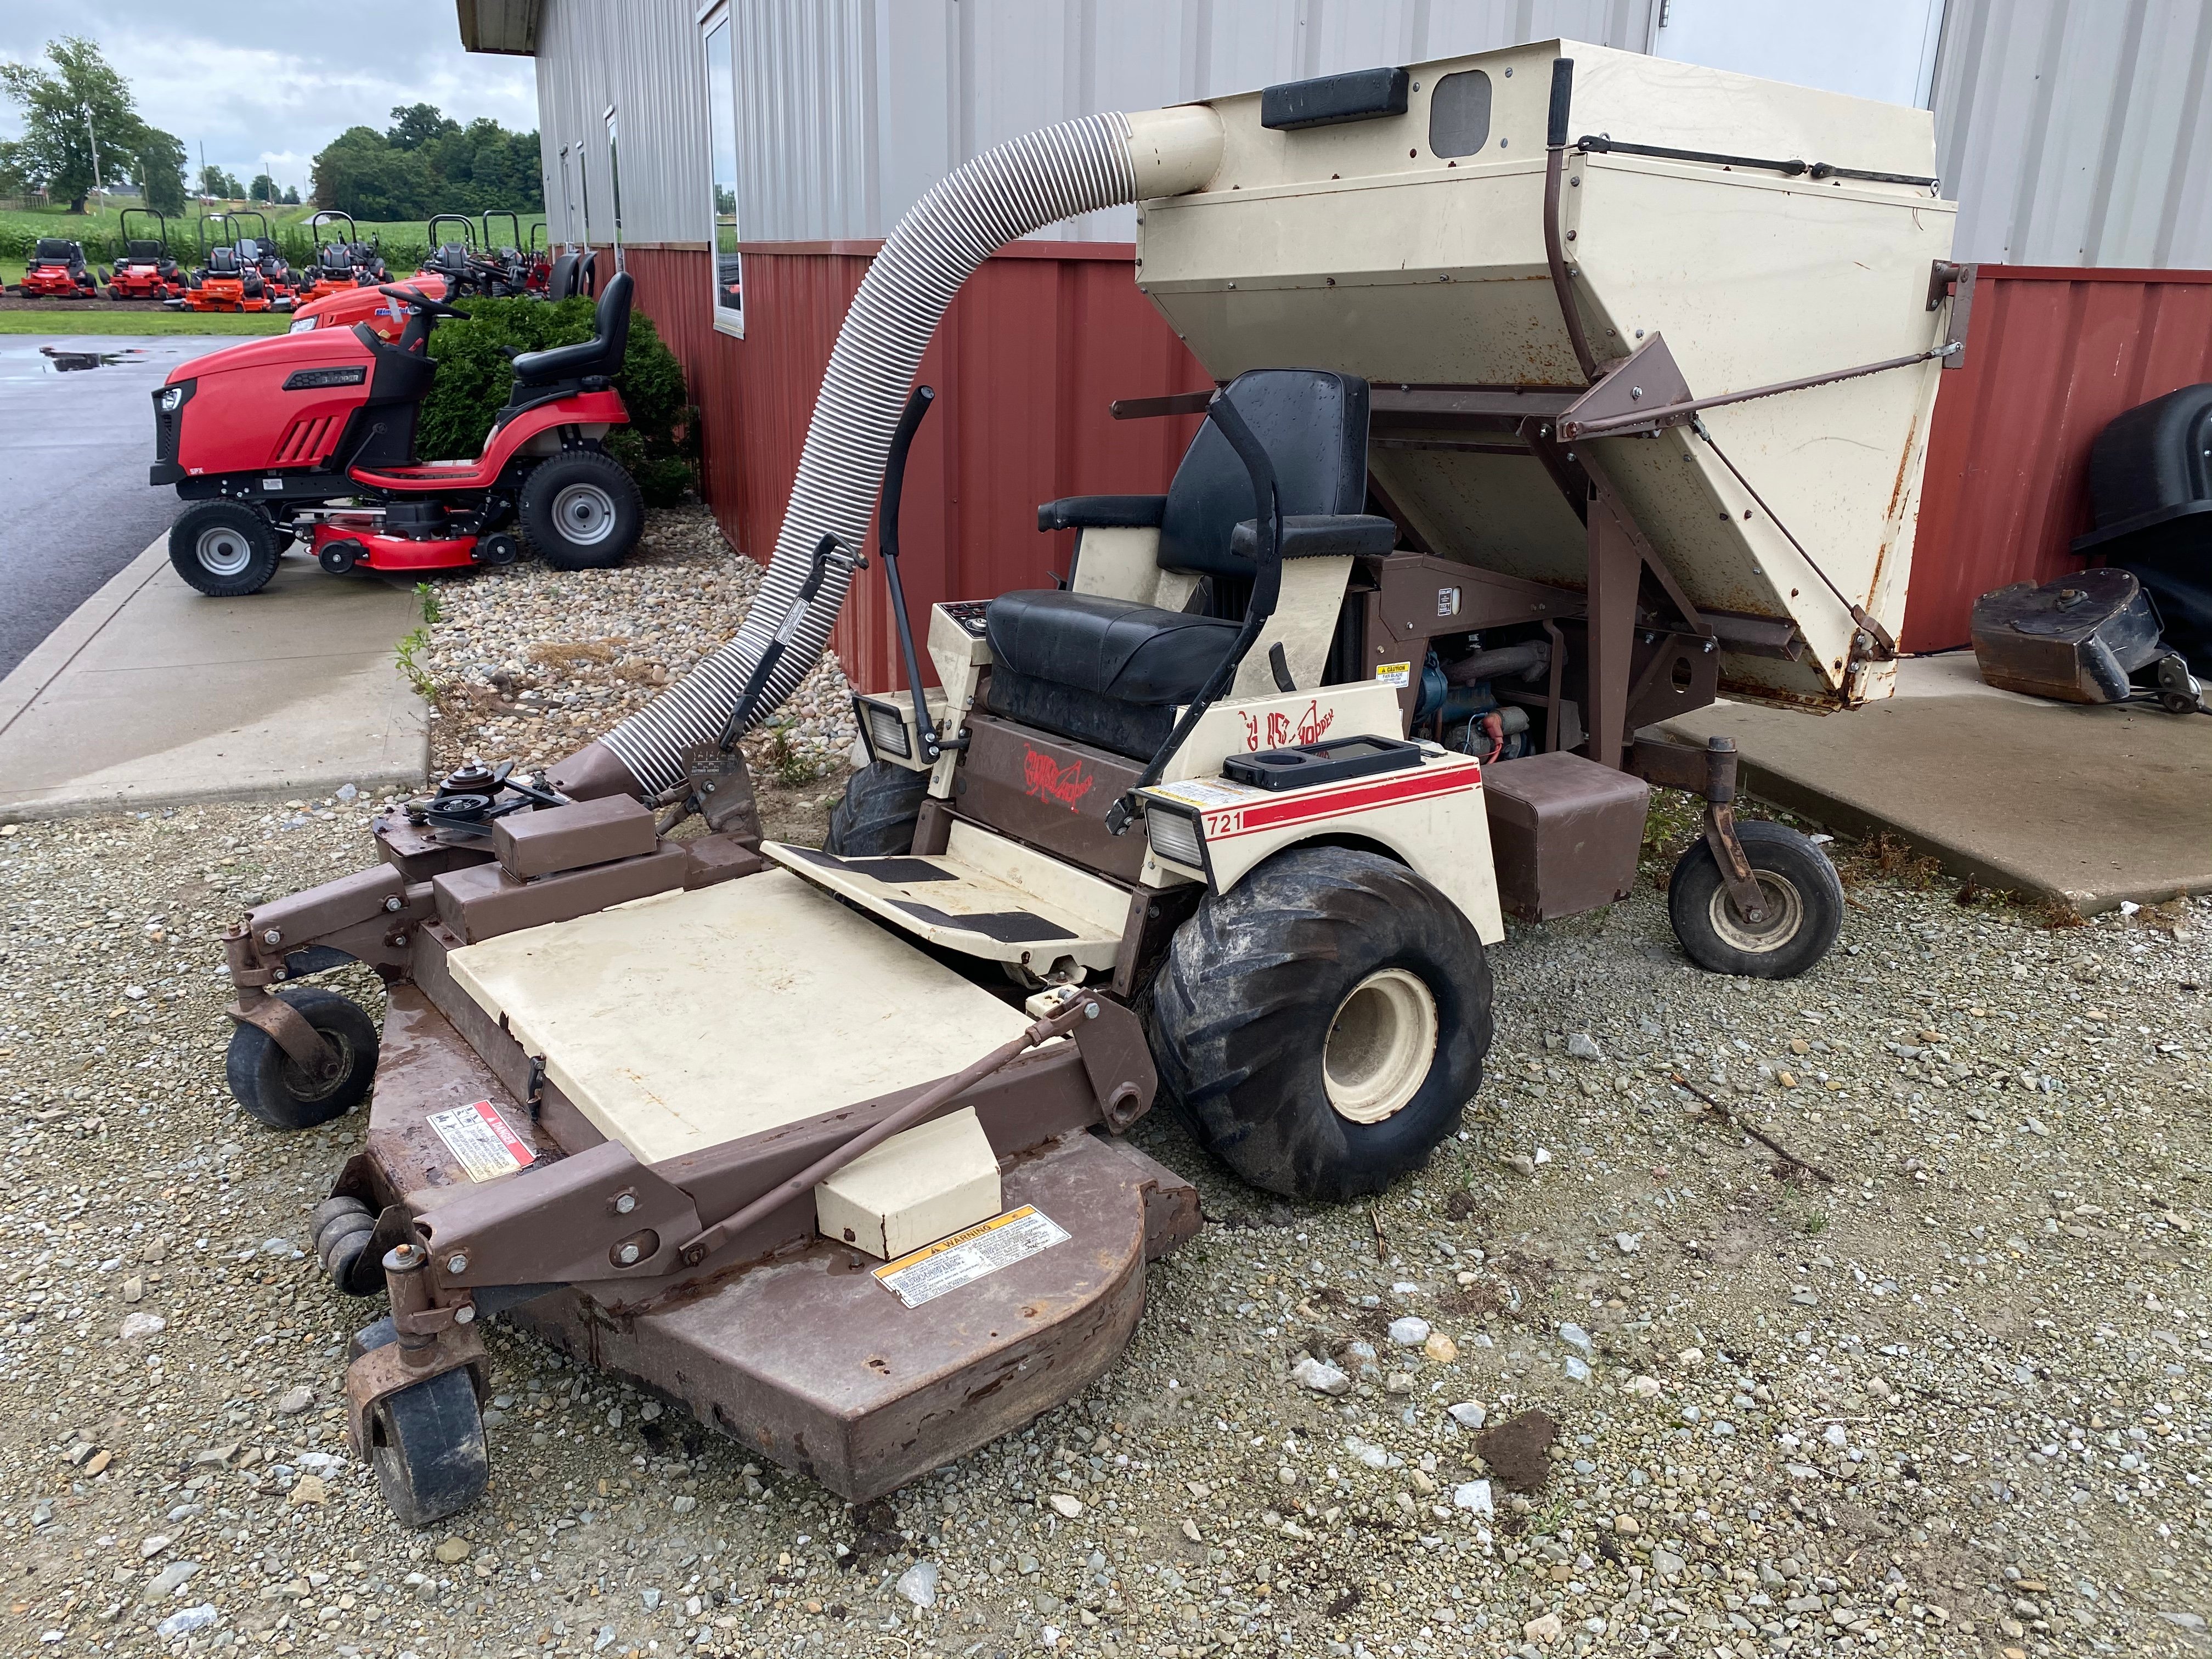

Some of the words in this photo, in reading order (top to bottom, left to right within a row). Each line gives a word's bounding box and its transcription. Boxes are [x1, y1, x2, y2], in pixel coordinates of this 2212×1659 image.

[1207, 812, 1240, 835] 721
[489, 1135, 500, 1144] KEEP
[492, 1122, 517, 1146] DANGER
[943, 1224, 992, 1248] WARNING
